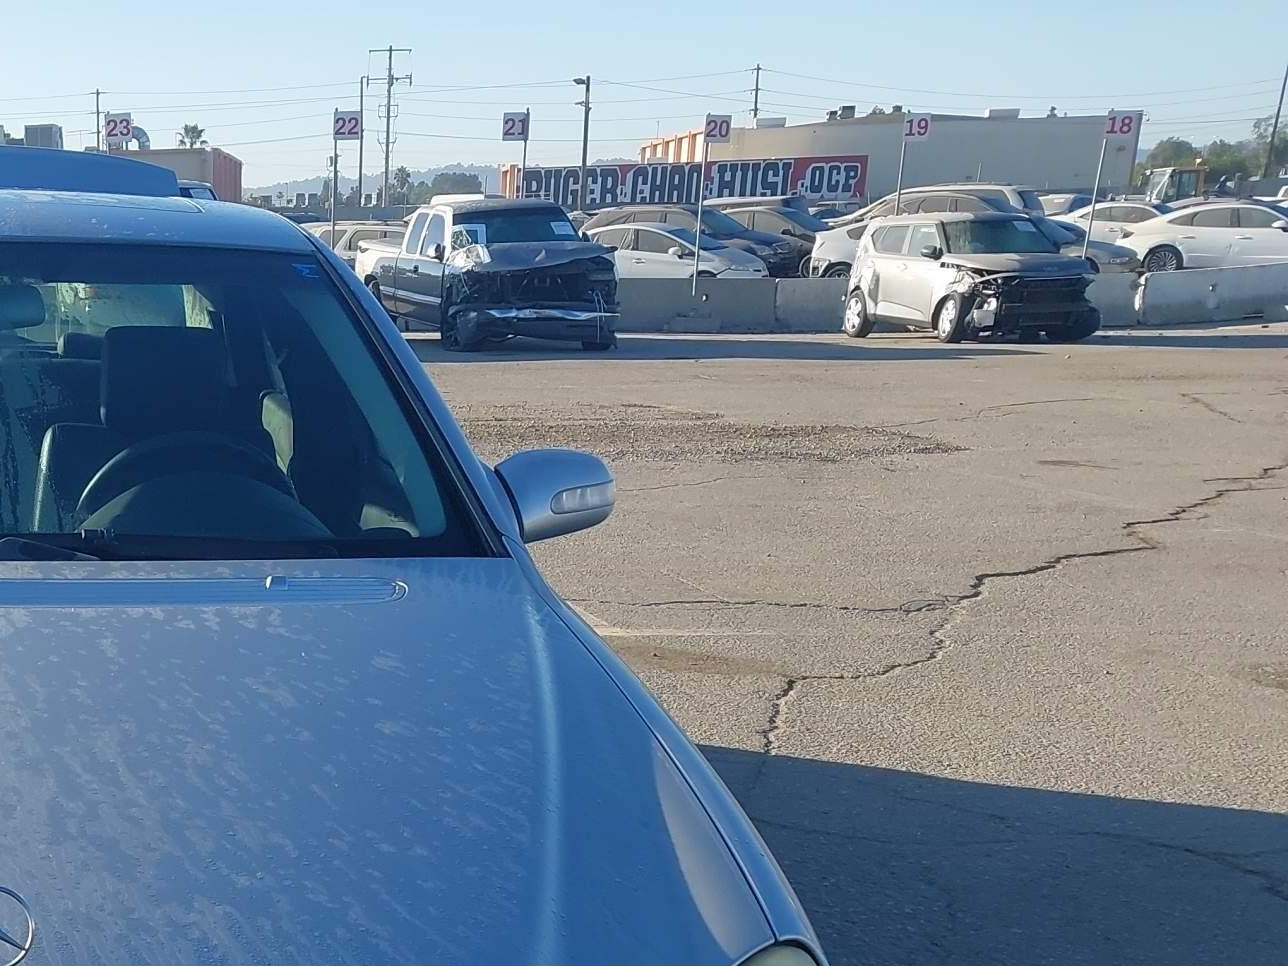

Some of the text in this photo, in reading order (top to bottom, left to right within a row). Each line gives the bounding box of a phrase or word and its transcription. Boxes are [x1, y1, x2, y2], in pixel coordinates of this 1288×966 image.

[107, 119, 131, 137] 23
[335, 117, 359, 135] 22
[504, 118, 526, 135] 21
[706, 120, 730, 138] 20
[905, 118, 929, 136] 19
[1106, 116, 1133, 134] 18
